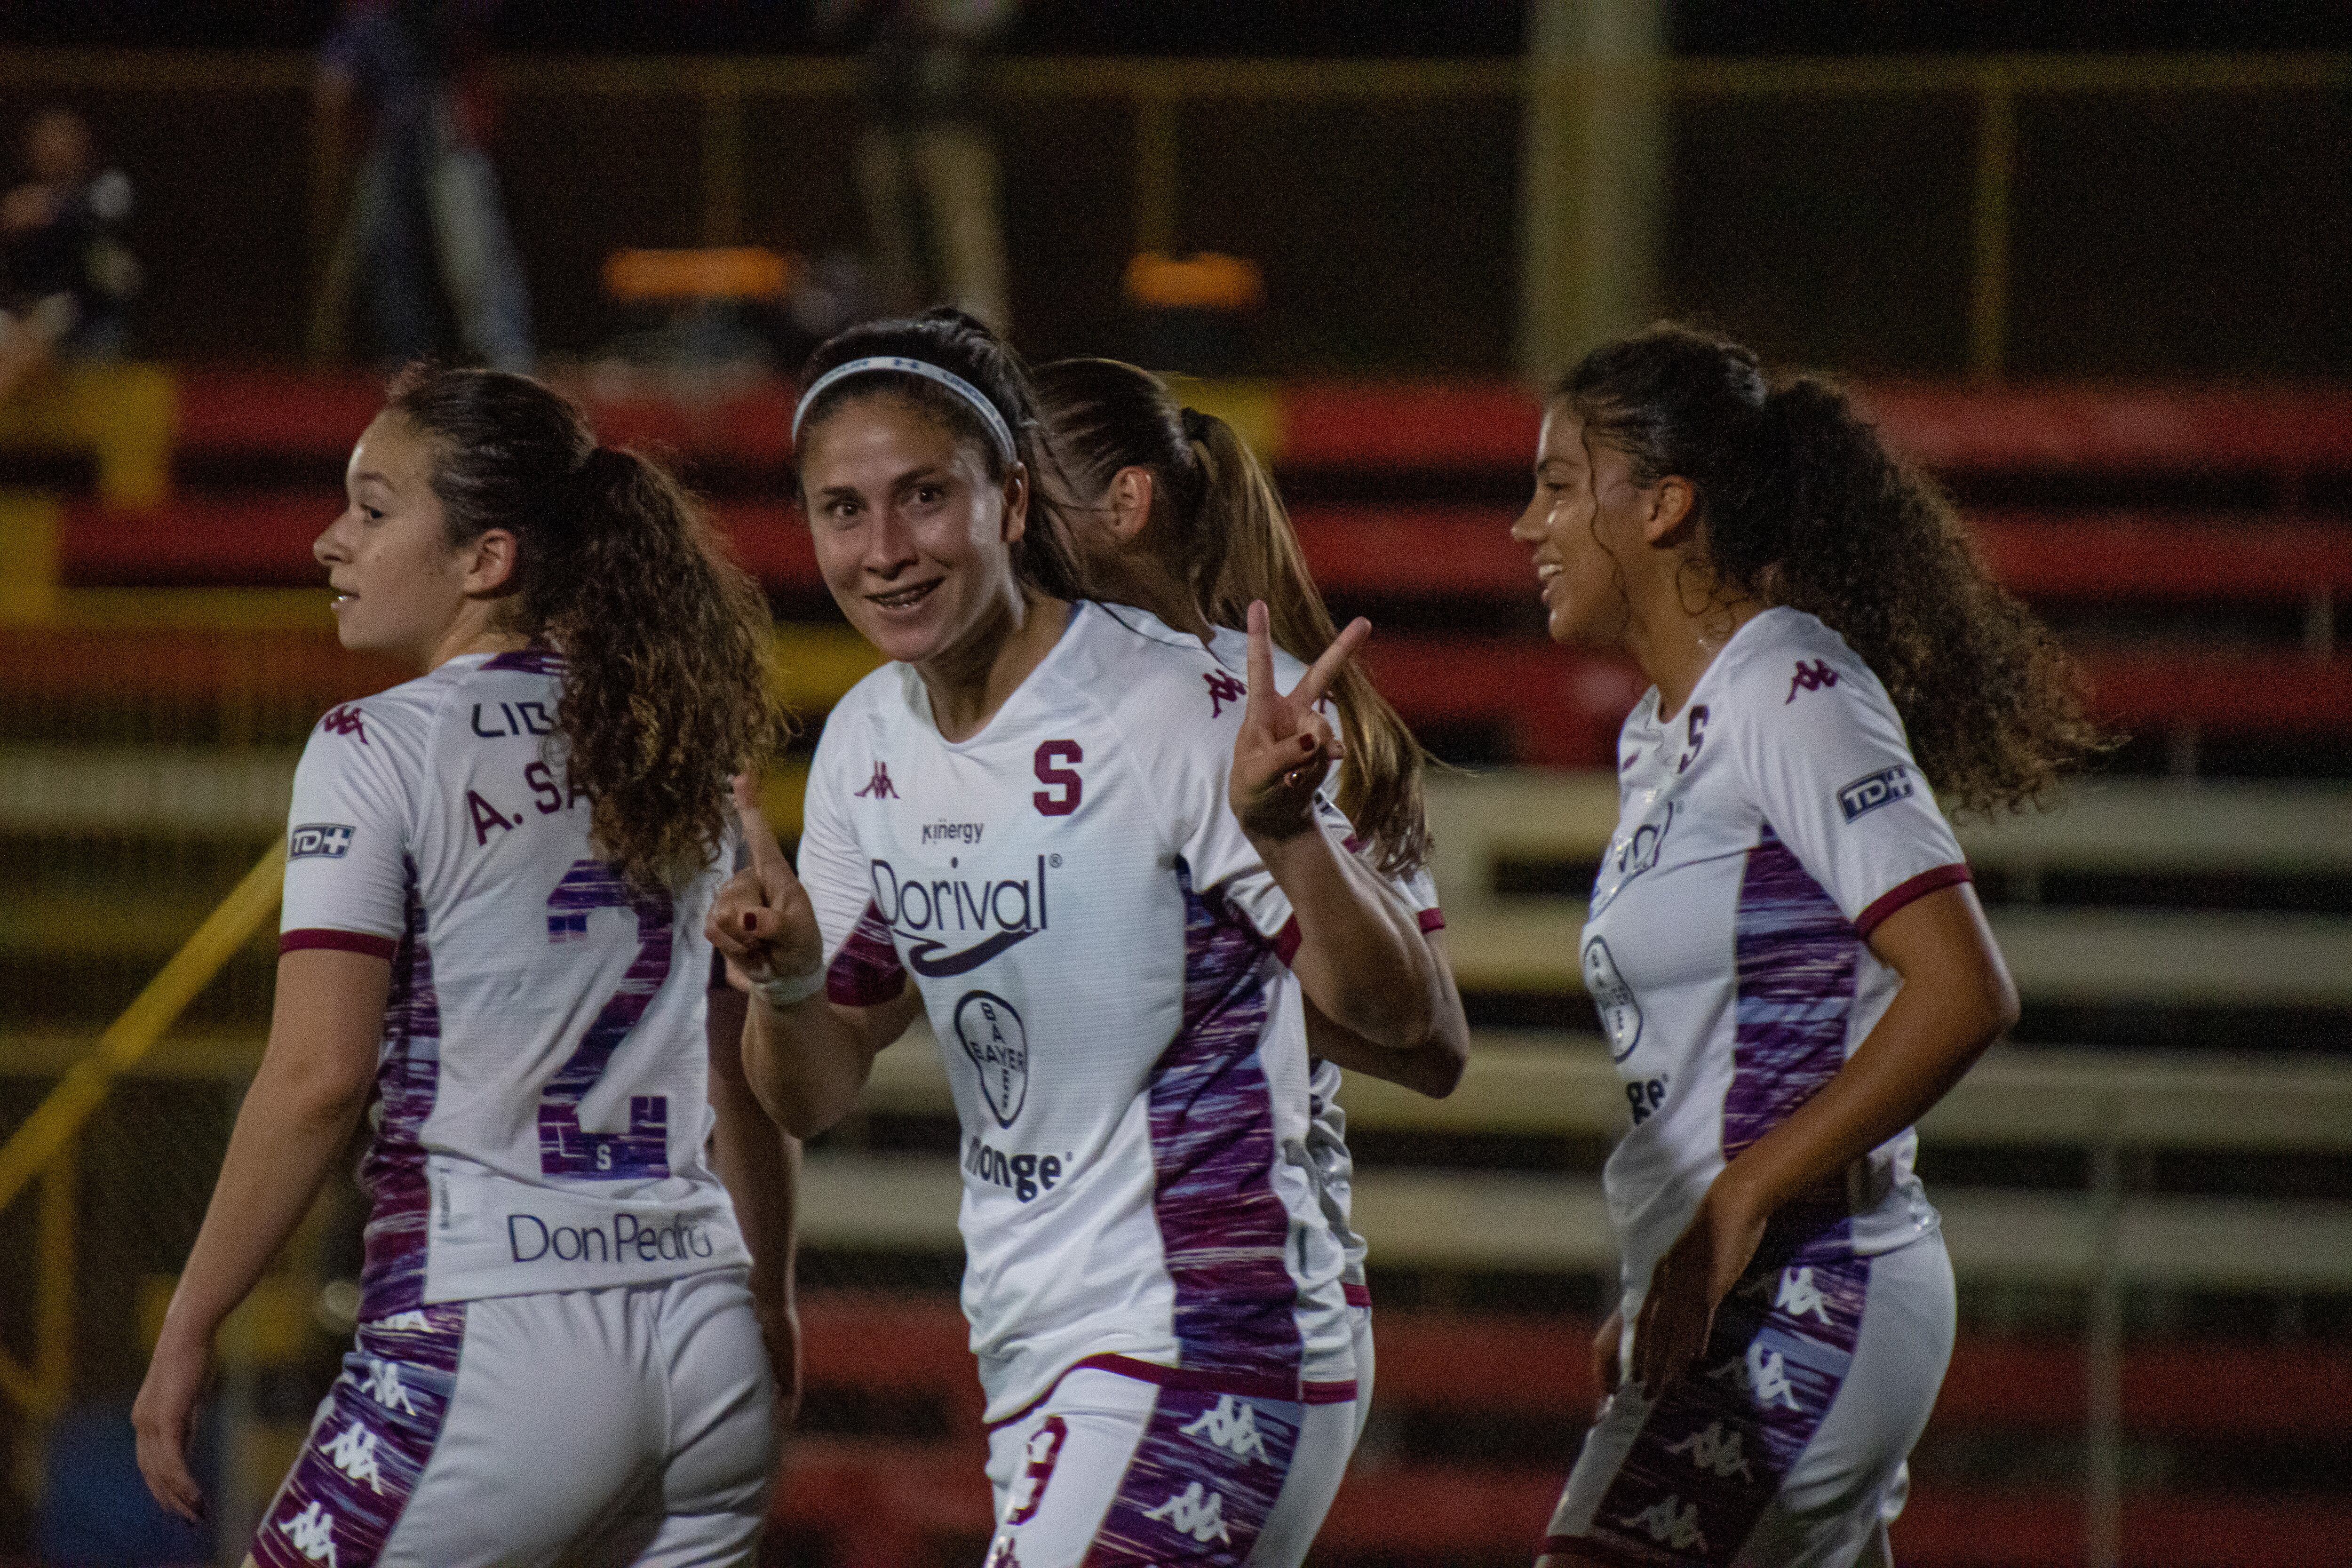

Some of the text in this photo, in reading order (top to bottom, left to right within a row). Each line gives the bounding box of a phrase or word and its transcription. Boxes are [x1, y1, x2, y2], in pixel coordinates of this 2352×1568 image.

[1676, 705, 1709, 774] S
[1033, 740, 1083, 816] S
[467, 790, 523, 847] A.
[538, 860, 675, 1179] 2
[596, 1144, 612, 1171] S
